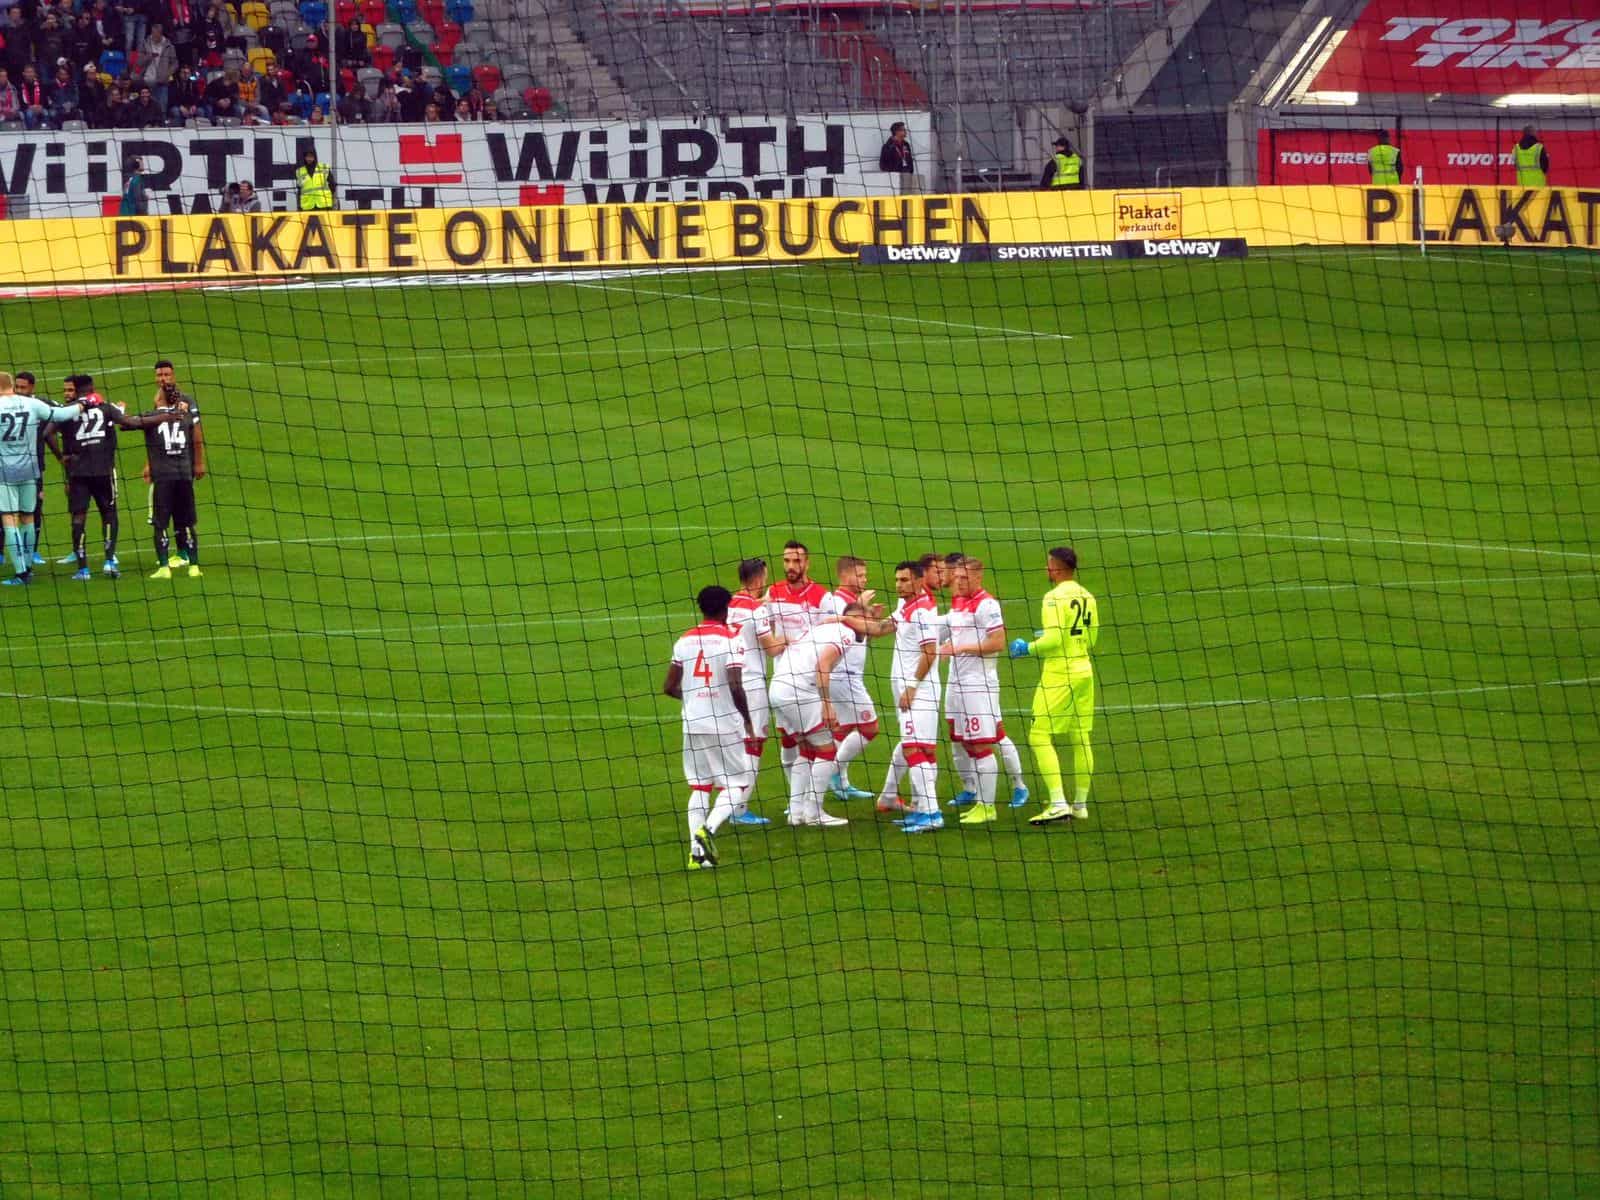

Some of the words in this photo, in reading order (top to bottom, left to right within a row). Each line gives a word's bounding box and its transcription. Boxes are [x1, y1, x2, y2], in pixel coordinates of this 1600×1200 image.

[1280, 152, 1327, 165] TOYO
[1447, 153, 1494, 166] TOYO
[1118, 205, 1177, 219] Plakat-
[115, 212, 415, 276] PLAKATE
[445, 205, 703, 266] ONLINE
[734, 197, 990, 258] BUCHEN
[887, 245, 961, 263] betway
[998, 245, 1113, 259] SPORTWETTEN
[1144, 240, 1220, 257] betway
[1, 411, 30, 442] 27
[75, 408, 106, 440] 22
[158, 421, 186, 450] 14
[1069, 598, 1092, 636] 24
[693, 649, 713, 688] 4
[905, 720, 915, 735] 5
